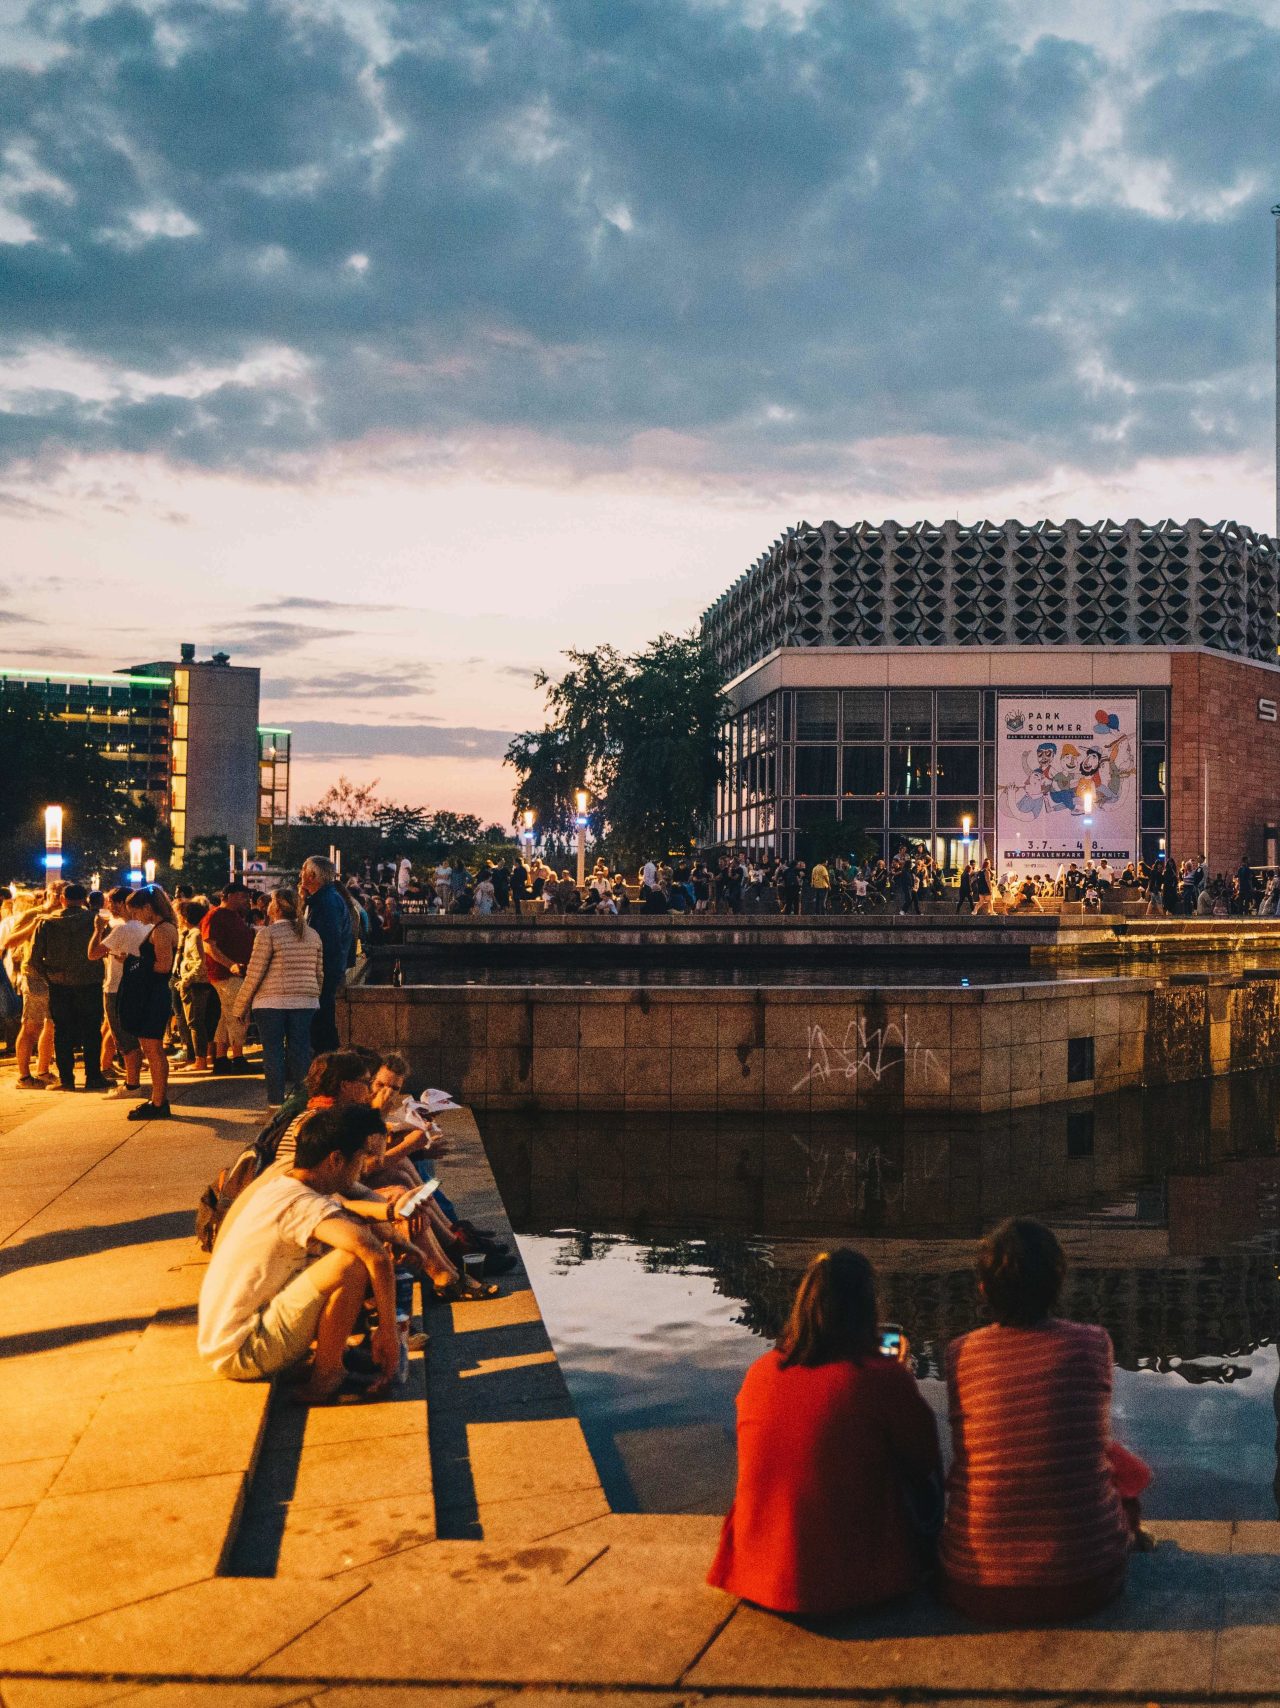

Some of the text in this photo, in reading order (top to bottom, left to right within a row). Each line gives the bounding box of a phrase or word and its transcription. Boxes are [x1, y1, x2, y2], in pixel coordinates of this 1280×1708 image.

[1028, 712, 1060, 720] PARK
[1028, 724, 1082, 732] SOMMER
[1027, 840, 1053, 850] 3.7.
